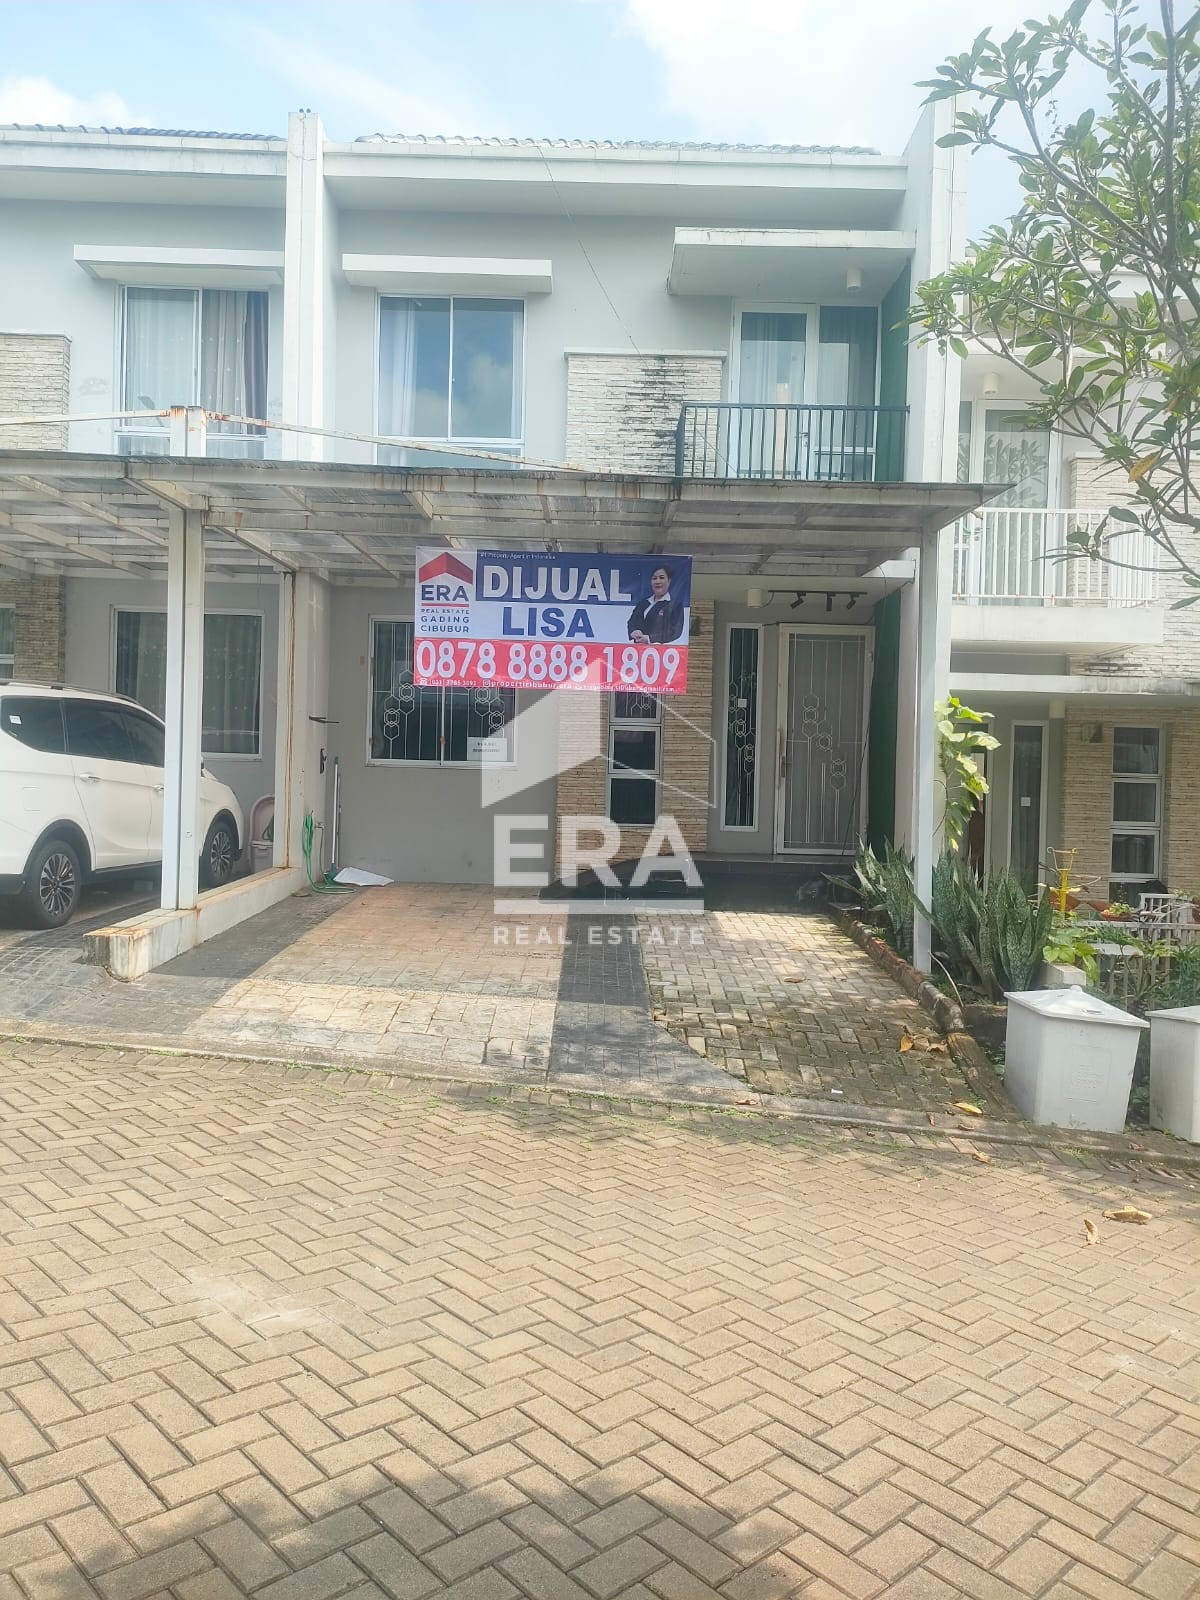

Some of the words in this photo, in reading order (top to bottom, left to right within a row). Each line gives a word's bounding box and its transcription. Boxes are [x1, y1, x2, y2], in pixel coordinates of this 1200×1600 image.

[421, 585, 469, 602] ERA
[482, 565, 632, 602] DIJUAL
[420, 625, 469, 633] CIBUBUR
[502, 606, 595, 638] LISA
[416, 640, 497, 679] 0878
[507, 643, 588, 683] 8888
[602, 646, 680, 685] 1809
